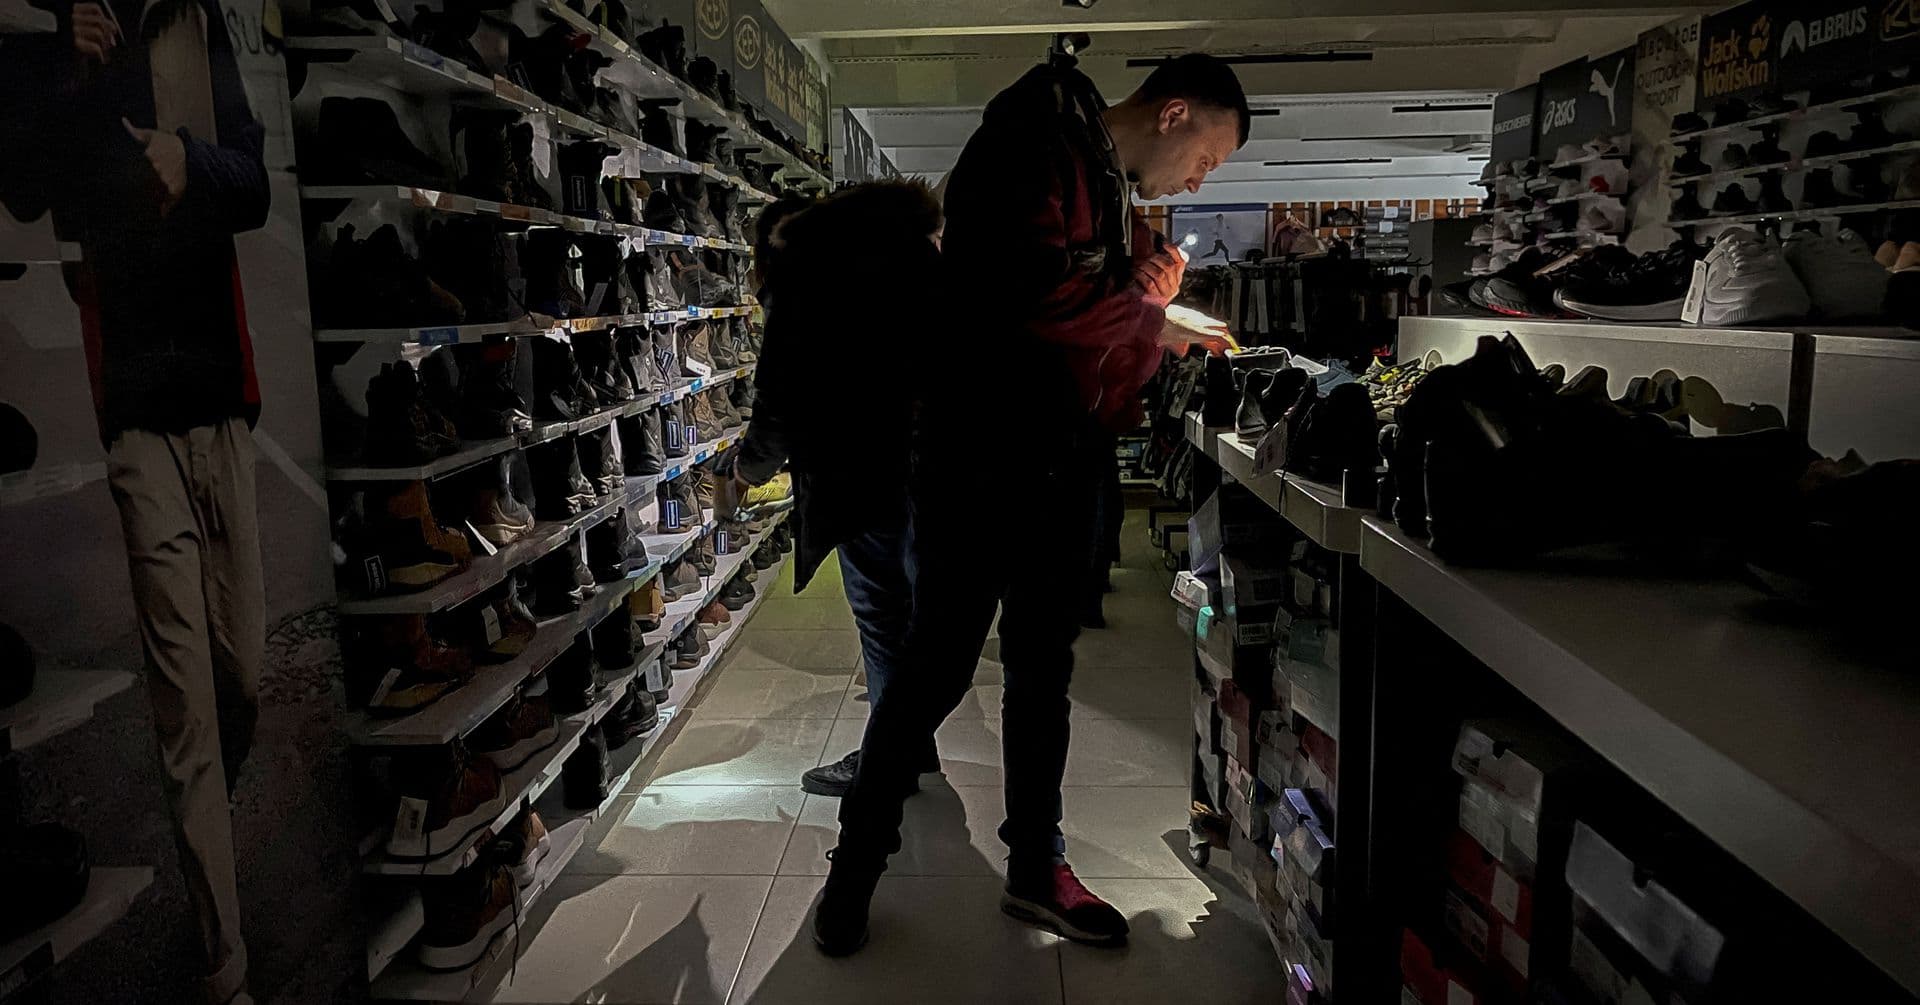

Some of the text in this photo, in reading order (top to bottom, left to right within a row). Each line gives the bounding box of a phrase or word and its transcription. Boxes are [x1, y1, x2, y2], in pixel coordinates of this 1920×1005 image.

[1808, 7, 1867, 48] ELBRUS
[1704, 28, 1740, 68] Jack
[1703, 58, 1769, 98] Wolfskin
